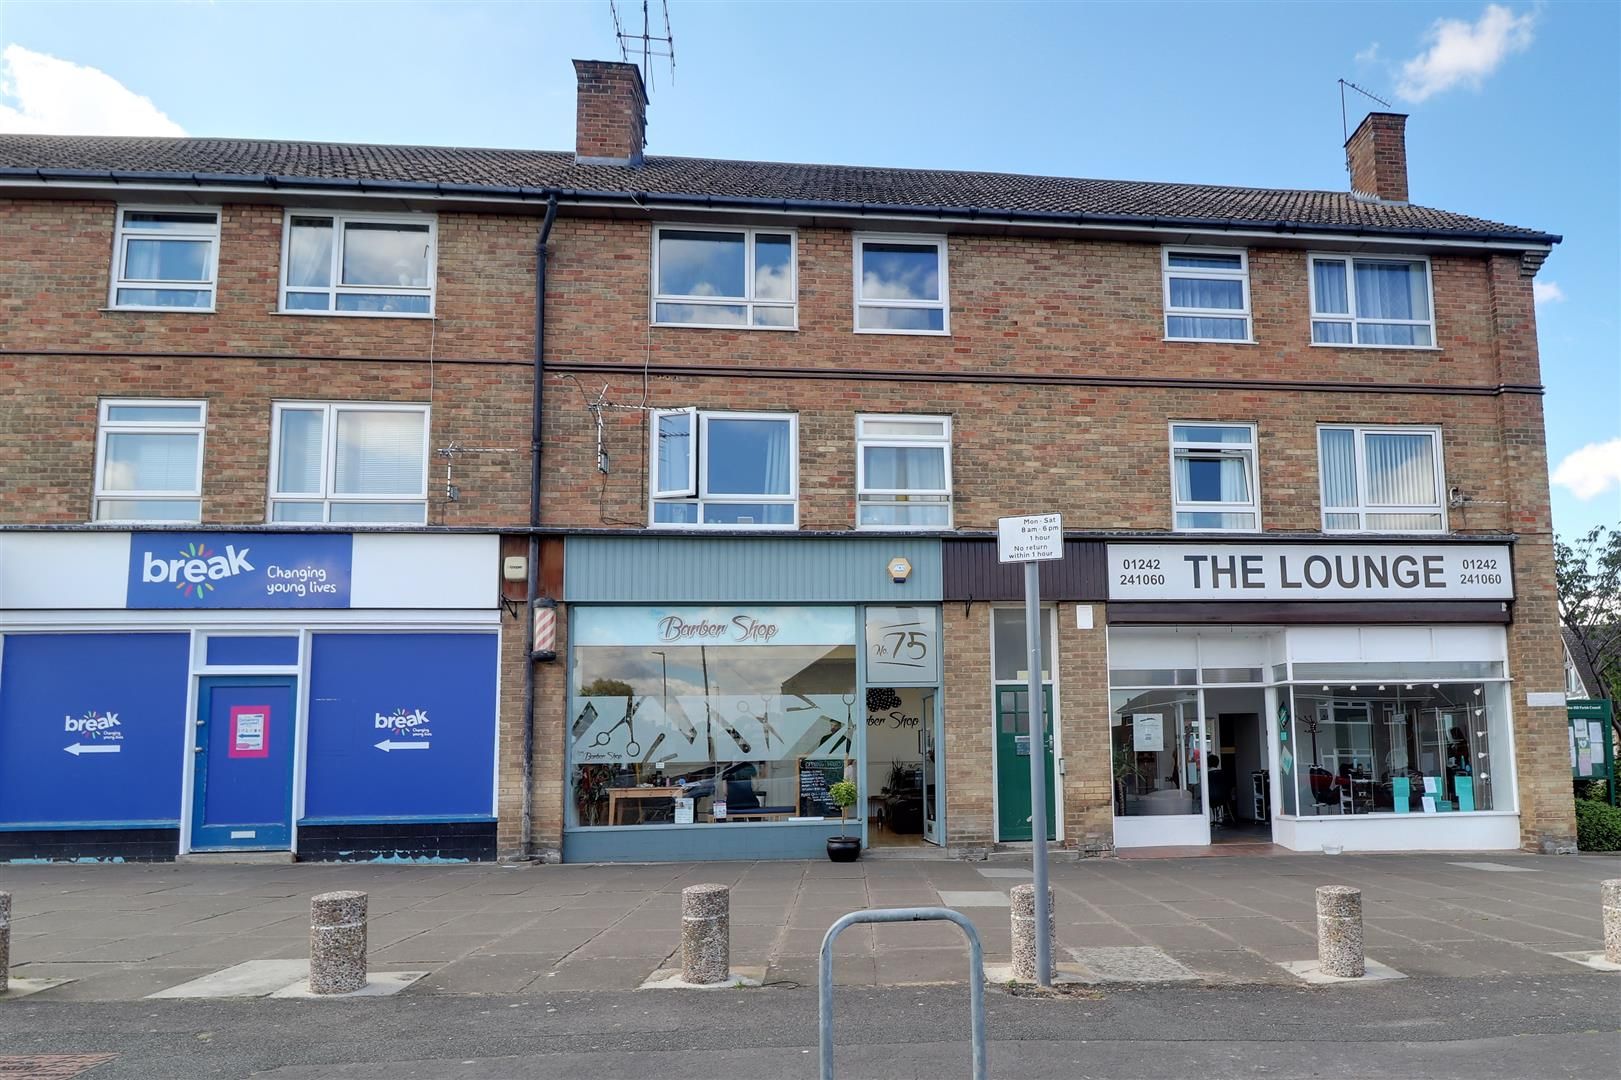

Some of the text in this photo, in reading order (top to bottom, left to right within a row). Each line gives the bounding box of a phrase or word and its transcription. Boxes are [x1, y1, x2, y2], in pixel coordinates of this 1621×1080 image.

[142, 544, 256, 583] break
[1122, 559, 1161, 571] 01242
[1183, 554, 1447, 589] THE LOUNGE
[1461, 559, 1498, 571] 01242
[267, 565, 327, 582] Changing
[1119, 573, 1166, 587] 241060
[1459, 574, 1503, 586] 241060
[266, 581, 337, 597] young lives
[658, 615, 779, 643] Barber Shop
[883, 631, 928, 660] 75
[65, 711, 121, 731] break
[375, 709, 430, 728] break
[889, 711, 919, 729] Shop
[585, 752, 606, 760] Barber
[607, 751, 622, 759] Shop
